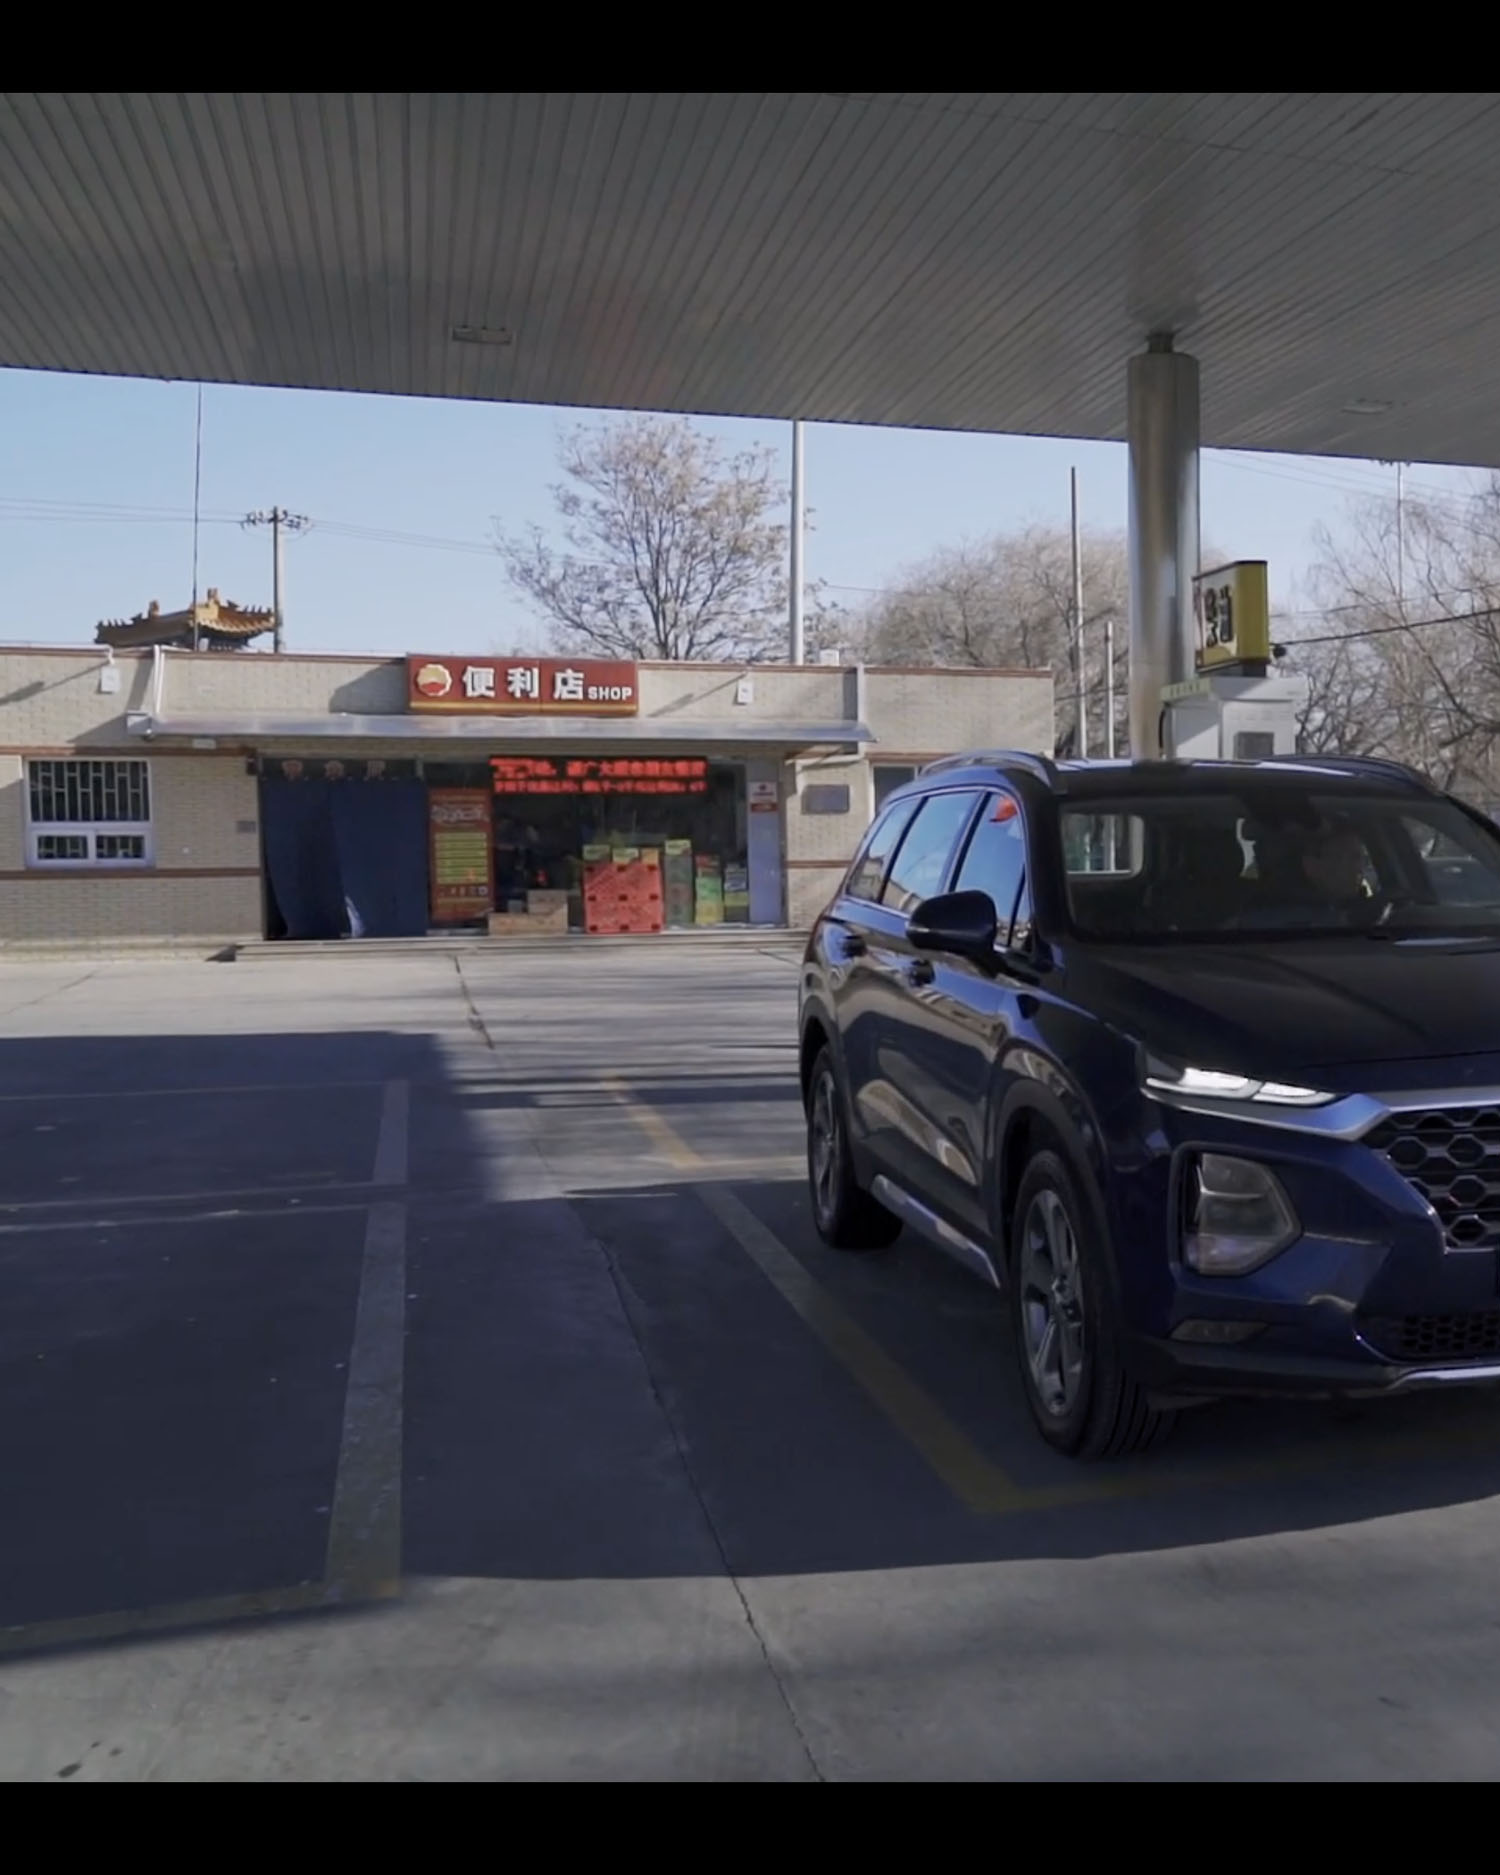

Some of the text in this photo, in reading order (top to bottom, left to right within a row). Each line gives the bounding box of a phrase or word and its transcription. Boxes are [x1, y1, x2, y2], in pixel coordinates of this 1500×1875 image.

[462, 665, 633, 701] 便利店 SHOP
